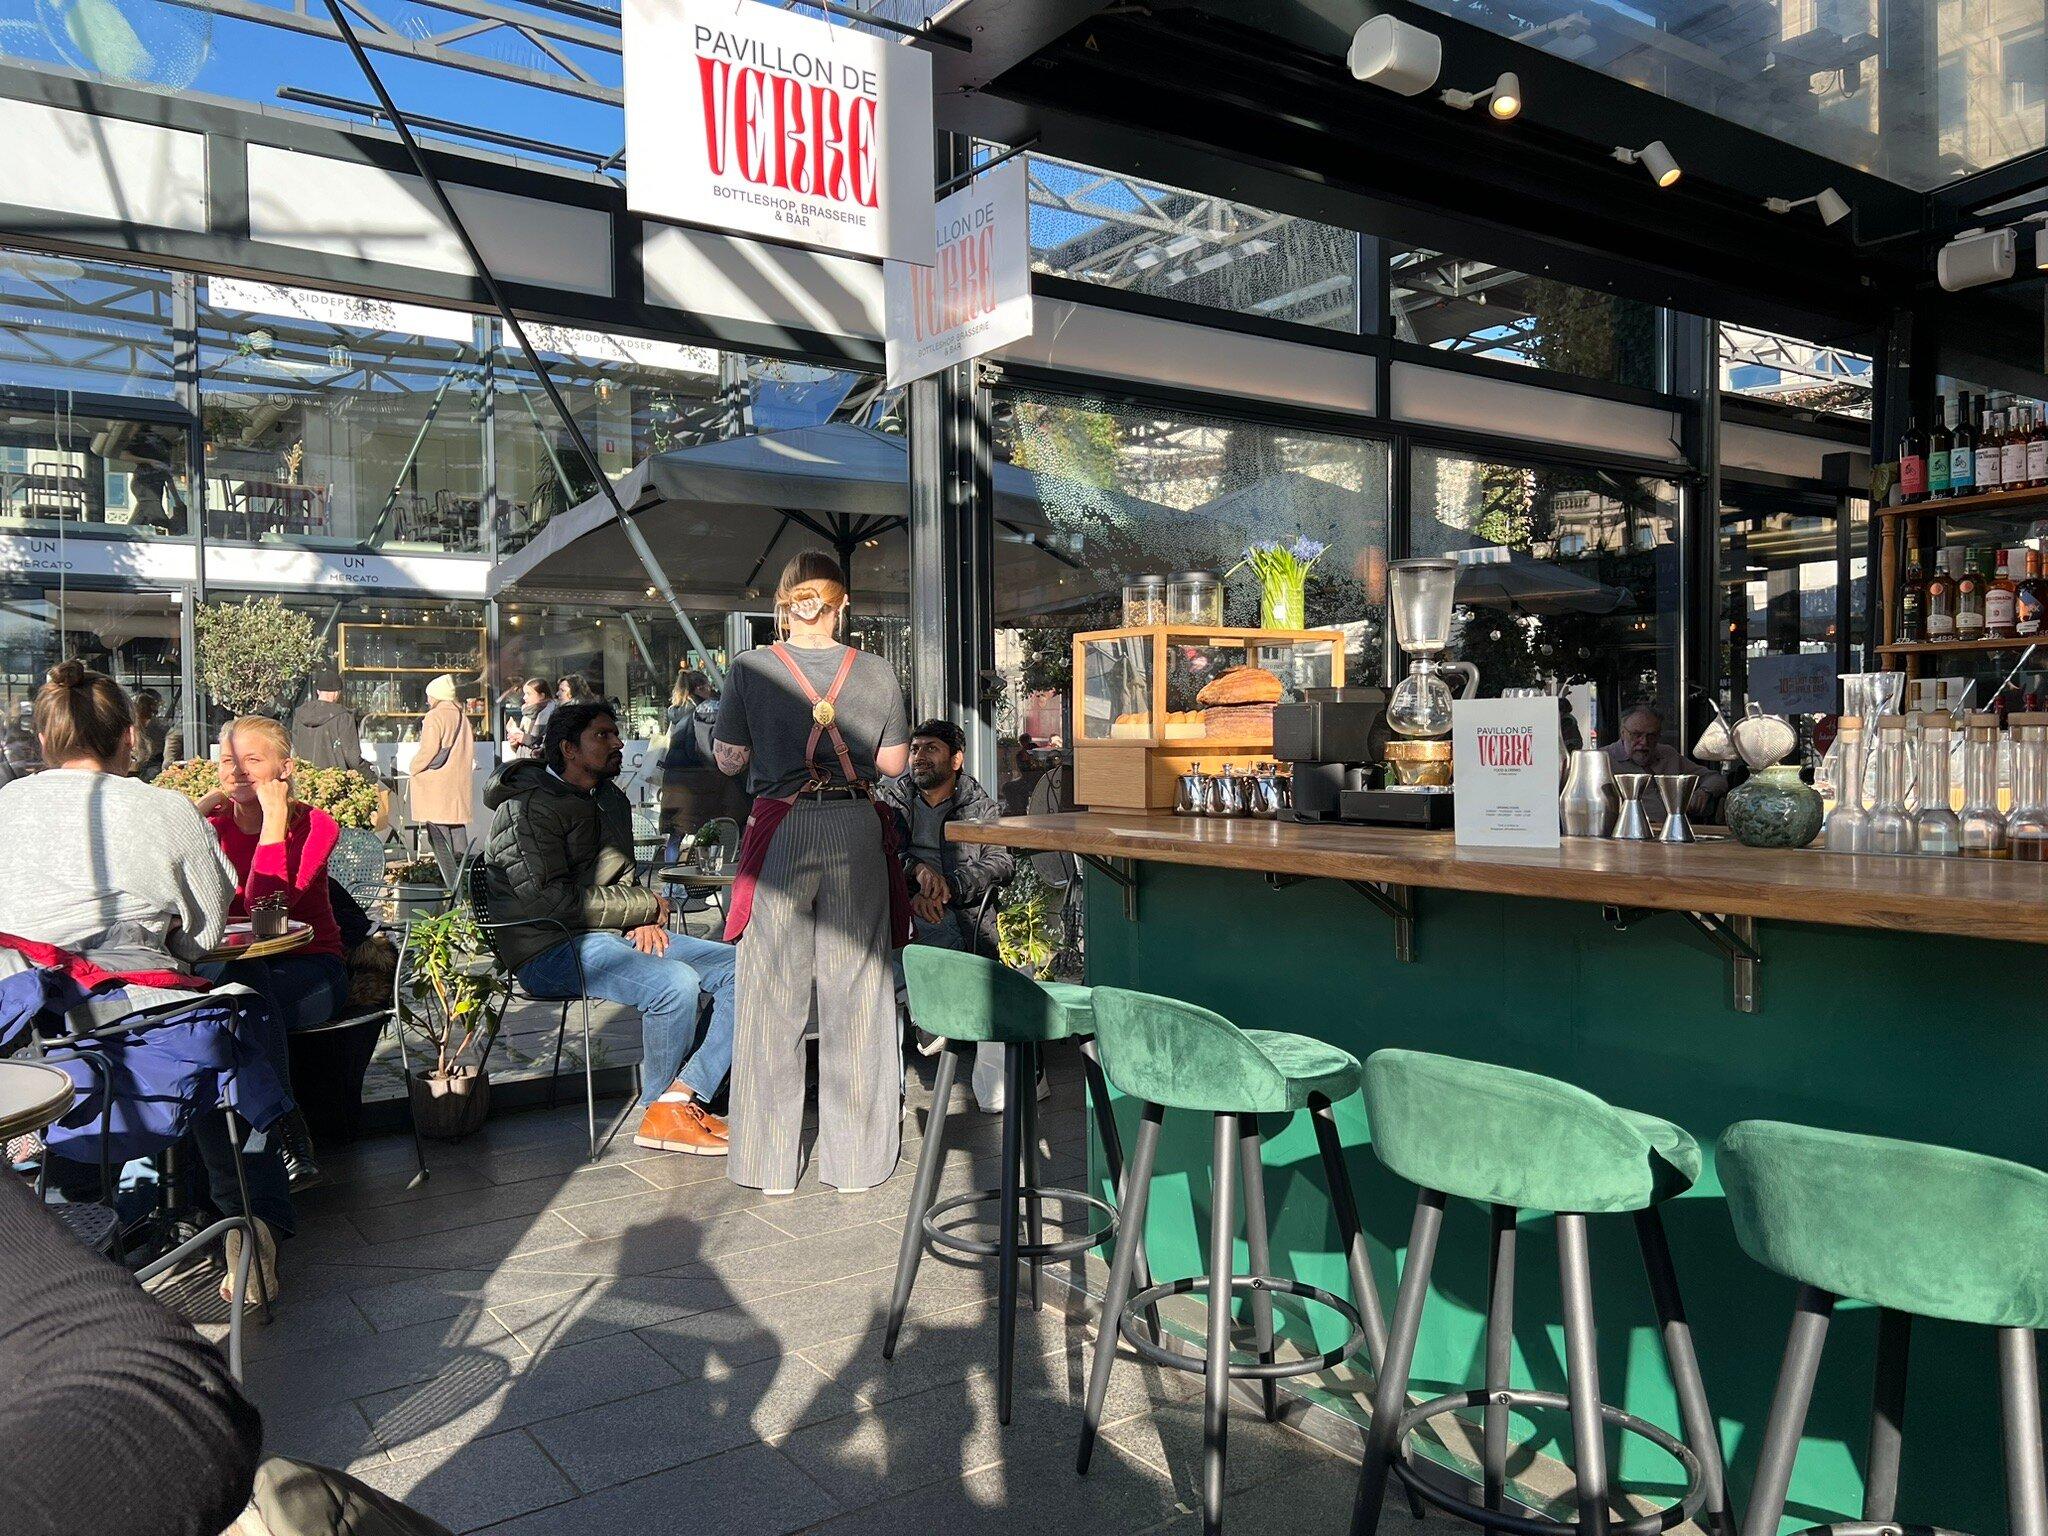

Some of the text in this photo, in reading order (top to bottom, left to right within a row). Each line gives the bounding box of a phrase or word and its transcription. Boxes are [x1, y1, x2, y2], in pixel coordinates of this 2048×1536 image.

[695, 24, 878, 97] PAVILLON DE
[695, 54, 879, 209] VERRE
[713, 185, 867, 227] BOTTLESHOP, BRASSERIE
[774, 210, 811, 227] & BAR
[936, 202, 995, 247] LLON DE
[910, 225, 997, 342] VERRE
[956, 321, 990, 343] BRASSERIE
[949, 342, 962, 355] BAR
[30, 541, 56, 553] UN
[13, 560, 73, 570] MERCATO
[344, 557, 365, 569] UN
[329, 572, 379, 583] MERCATO
[1477, 727, 1519, 735] PAVILLON
[1478, 734, 1533, 767] VERRE
